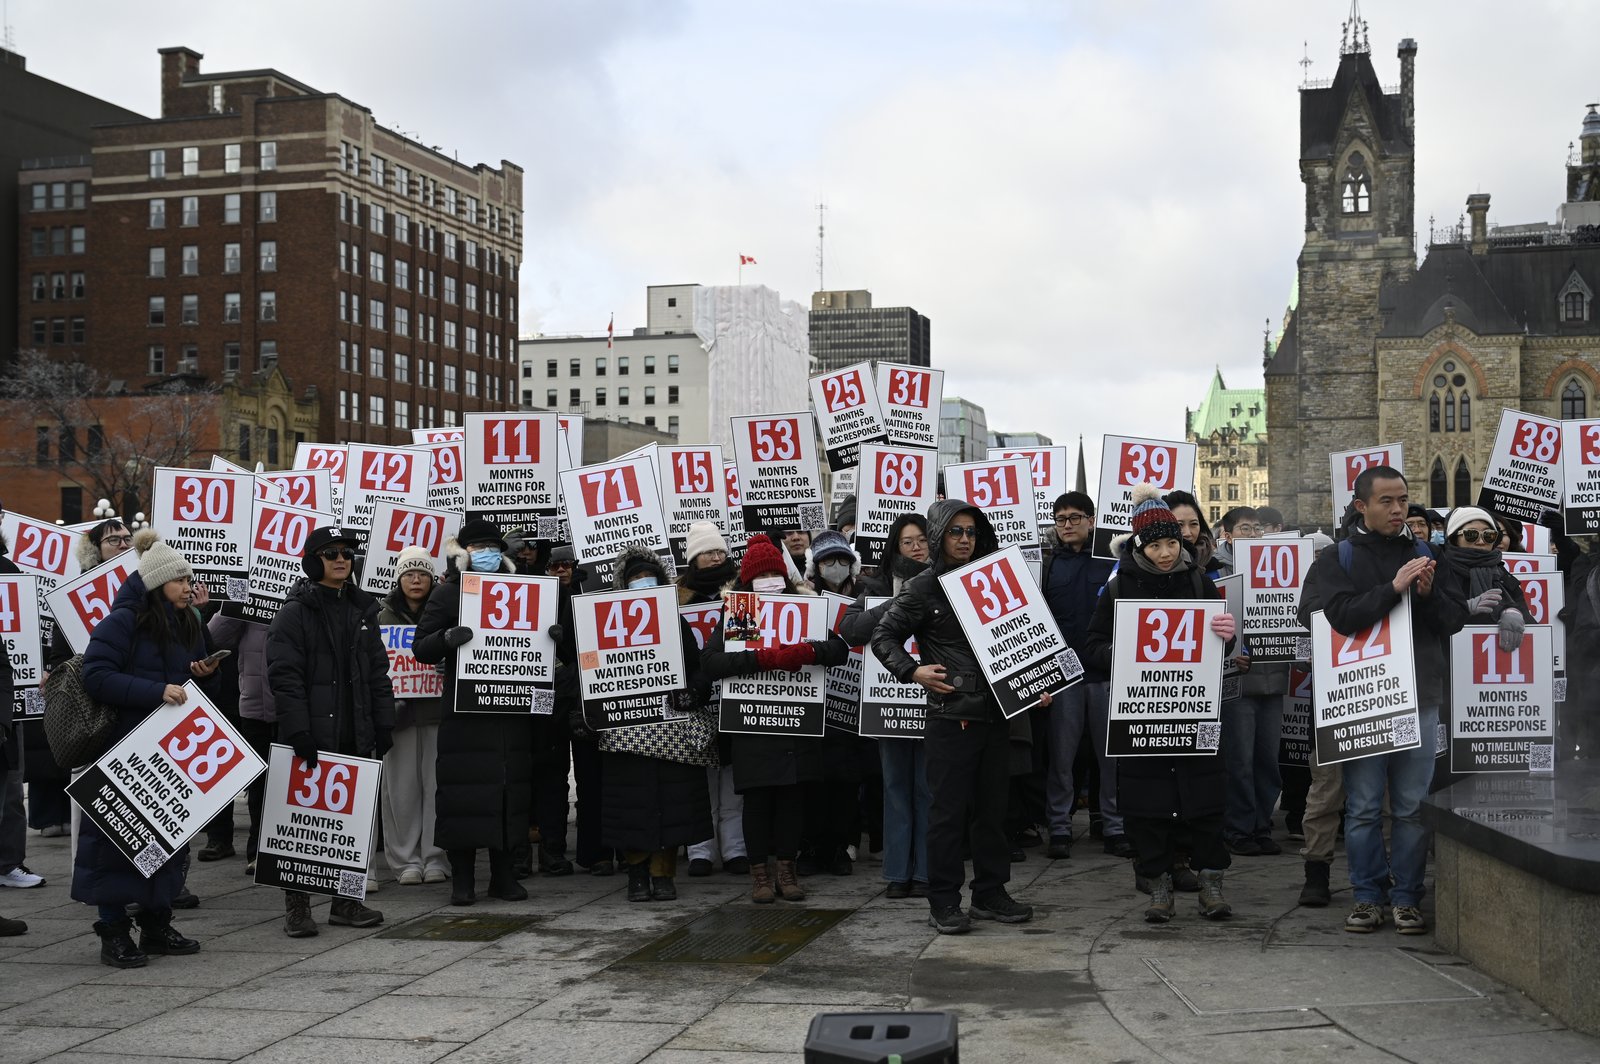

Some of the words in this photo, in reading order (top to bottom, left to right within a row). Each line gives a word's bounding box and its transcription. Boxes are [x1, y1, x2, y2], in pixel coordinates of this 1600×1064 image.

[827, 373, 860, 411] 25
[893, 370, 923, 406] 31
[834, 409, 865, 423] MONTHS
[891, 409, 922, 421] MONTHS
[829, 421, 859, 435] WAITING
[861, 416, 875, 425] FOR
[915, 422, 930, 432] FOR
[493, 421, 531, 462] 11
[755, 420, 796, 461] 53
[828, 434, 849, 446] IRCC
[849, 425, 882, 440] RESPONSE
[900, 430, 934, 443] RESPONSE
[1516, 422, 1558, 462] 38
[366, 452, 406, 491] 42
[678, 453, 708, 492] 15
[758, 466, 798, 476] MONTHS
[1125, 444, 1170, 488] 39
[1510, 460, 1548, 475] MONTHS
[490, 469, 533, 480] MONTHS
[881, 454, 917, 495] 68
[1498, 468, 1535, 484] WAITING
[1537, 477, 1555, 488] FOR
[478, 483, 522, 493] WAITING
[525, 482, 545, 491] FOR
[750, 478, 789, 489] WAITING
[791, 477, 809, 487] FOR
[973, 467, 1013, 507] 51
[1489, 477, 1509, 488] IRCC
[1510, 483, 1557, 499] RESPONSE
[588, 469, 634, 514] 71
[746, 491, 766, 501] IRCC
[768, 489, 816, 500] RESPONSE
[1494, 494, 1505, 502] NO
[180, 478, 228, 522] 30
[472, 496, 495, 506] IRCC
[497, 494, 551, 505] RESPONSE
[680, 498, 711, 508] MONTHS
[879, 499, 916, 510] MONTHS
[1572, 494, 1594, 503] IRCC
[496, 513, 540, 522] TIMELINES
[673, 512, 704, 521] WAITING
[706, 510, 720, 518] FOR
[1506, 507, 1538, 519] RESULTS
[594, 514, 639, 530] MONTHS
[762, 517, 774, 525] NO
[1007, 521, 1026, 531] FOR
[1103, 514, 1126, 526] IRCC
[178, 527, 225, 539] MONTHS
[262, 512, 308, 555] 40
[393, 512, 438, 556] 40
[585, 527, 629, 545] WAITING
[633, 524, 653, 535] FOR
[18, 526, 63, 572] 20
[216, 543, 237, 553] FOR
[582, 547, 606, 558] IRCC
[257, 555, 300, 572] MONTHS
[596, 564, 608, 573] NO
[1256, 546, 1294, 587] 40
[970, 562, 1022, 619] 31
[1256, 594, 1294, 603] MONTHS
[488, 582, 531, 629] 31
[1246, 606, 1284, 616] WAITING
[604, 599, 654, 647] 42
[991, 613, 1030, 639] MONTHS
[485, 636, 530, 647] MONTHS
[988, 632, 1027, 658] WAITING
[1028, 623, 1047, 639] FOR
[1143, 610, 1196, 661] 34
[473, 650, 518, 661] WAITING
[522, 652, 541, 662] FOR
[606, 650, 655, 664] MONTHS
[990, 657, 1012, 675] IRCC
[1012, 634, 1058, 665] RESPONSE
[1482, 635, 1525, 682] 11
[465, 664, 490, 674] IRCC
[491, 665, 547, 676] RESPONSE
[595, 665, 643, 679] WAITING
[647, 662, 670, 673] FOR
[789, 671, 811, 682] FOR
[1008, 677, 1021, 690] NO
[1021, 659, 1058, 684] TIMELINES
[1141, 670, 1193, 682] MONTHS
[1338, 664, 1385, 685] MONTHS
[475, 684, 487, 693] NO
[589, 682, 614, 694] IRCC
[617, 674, 678, 691] RESPONSE
[729, 683, 756, 694] IRCC
[757, 684, 817, 697] RESPONSE
[1017, 687, 1029, 700] NO
[1030, 672, 1061, 692] RESULTS
[1327, 682, 1373, 703] WAITING
[1377, 677, 1400, 691] FOR
[870, 687, 895, 697] IRCC
[1127, 686, 1178, 698] WAITING
[1182, 686, 1205, 697] FOR
[1479, 691, 1527, 702] MONTHS
[478, 697, 491, 705] NO
[493, 697, 530, 706] RESULTS
[603, 702, 616, 711] NO
[1118, 702, 1144, 713] IRCC
[1147, 701, 1211, 713] RESPONSE
[1322, 705, 1345, 720] IRCC
[1347, 691, 1408, 715] RESPONSE
[740, 704, 755, 713] NO
[756, 705, 805, 715] TIMELINES
[880, 708, 893, 716] NO
[1467, 706, 1515, 717] WAITING
[1518, 706, 1540, 716] FOR
[608, 712, 621, 721] NO
[744, 716, 758, 725] NO
[759, 717, 800, 727] RESULTS
[884, 719, 898, 728] NO
[1129, 725, 1143, 734] NO
[1145, 724, 1197, 734] TIMELINES
[1460, 721, 1485, 732] IRCC
[1487, 720, 1546, 732] RESPONSE
[1334, 730, 1346, 740] NO
[1132, 737, 1146, 747] NO
[1149, 737, 1192, 746] RESULTS
[1339, 742, 1351, 752] NO
[1471, 742, 1484, 751] NO
[168, 717, 234, 783] 38
[1476, 754, 1488, 764] NO
[149, 752, 193, 799] MONTHS
[127, 753, 170, 799] WAITING
[167, 797, 190, 822] FOR
[294, 761, 350, 811] 36
[107, 758, 134, 785] IRCC
[129, 784, 183, 839] RESPONSE
[99, 785, 114, 801] NO
[113, 797, 155, 844] TIMELINES
[92, 798, 107, 813] NO
[104, 811, 141, 851] RESULTS
[291, 813, 343, 830] MONTHS
[277, 825, 327, 842] WAITING
[331, 834, 355, 847] FOR
[267, 838, 294, 851] IRCC
[296, 843, 361, 862] RESPONSE
[277, 860, 291, 870] NO
[280, 872, 294, 882] NO
